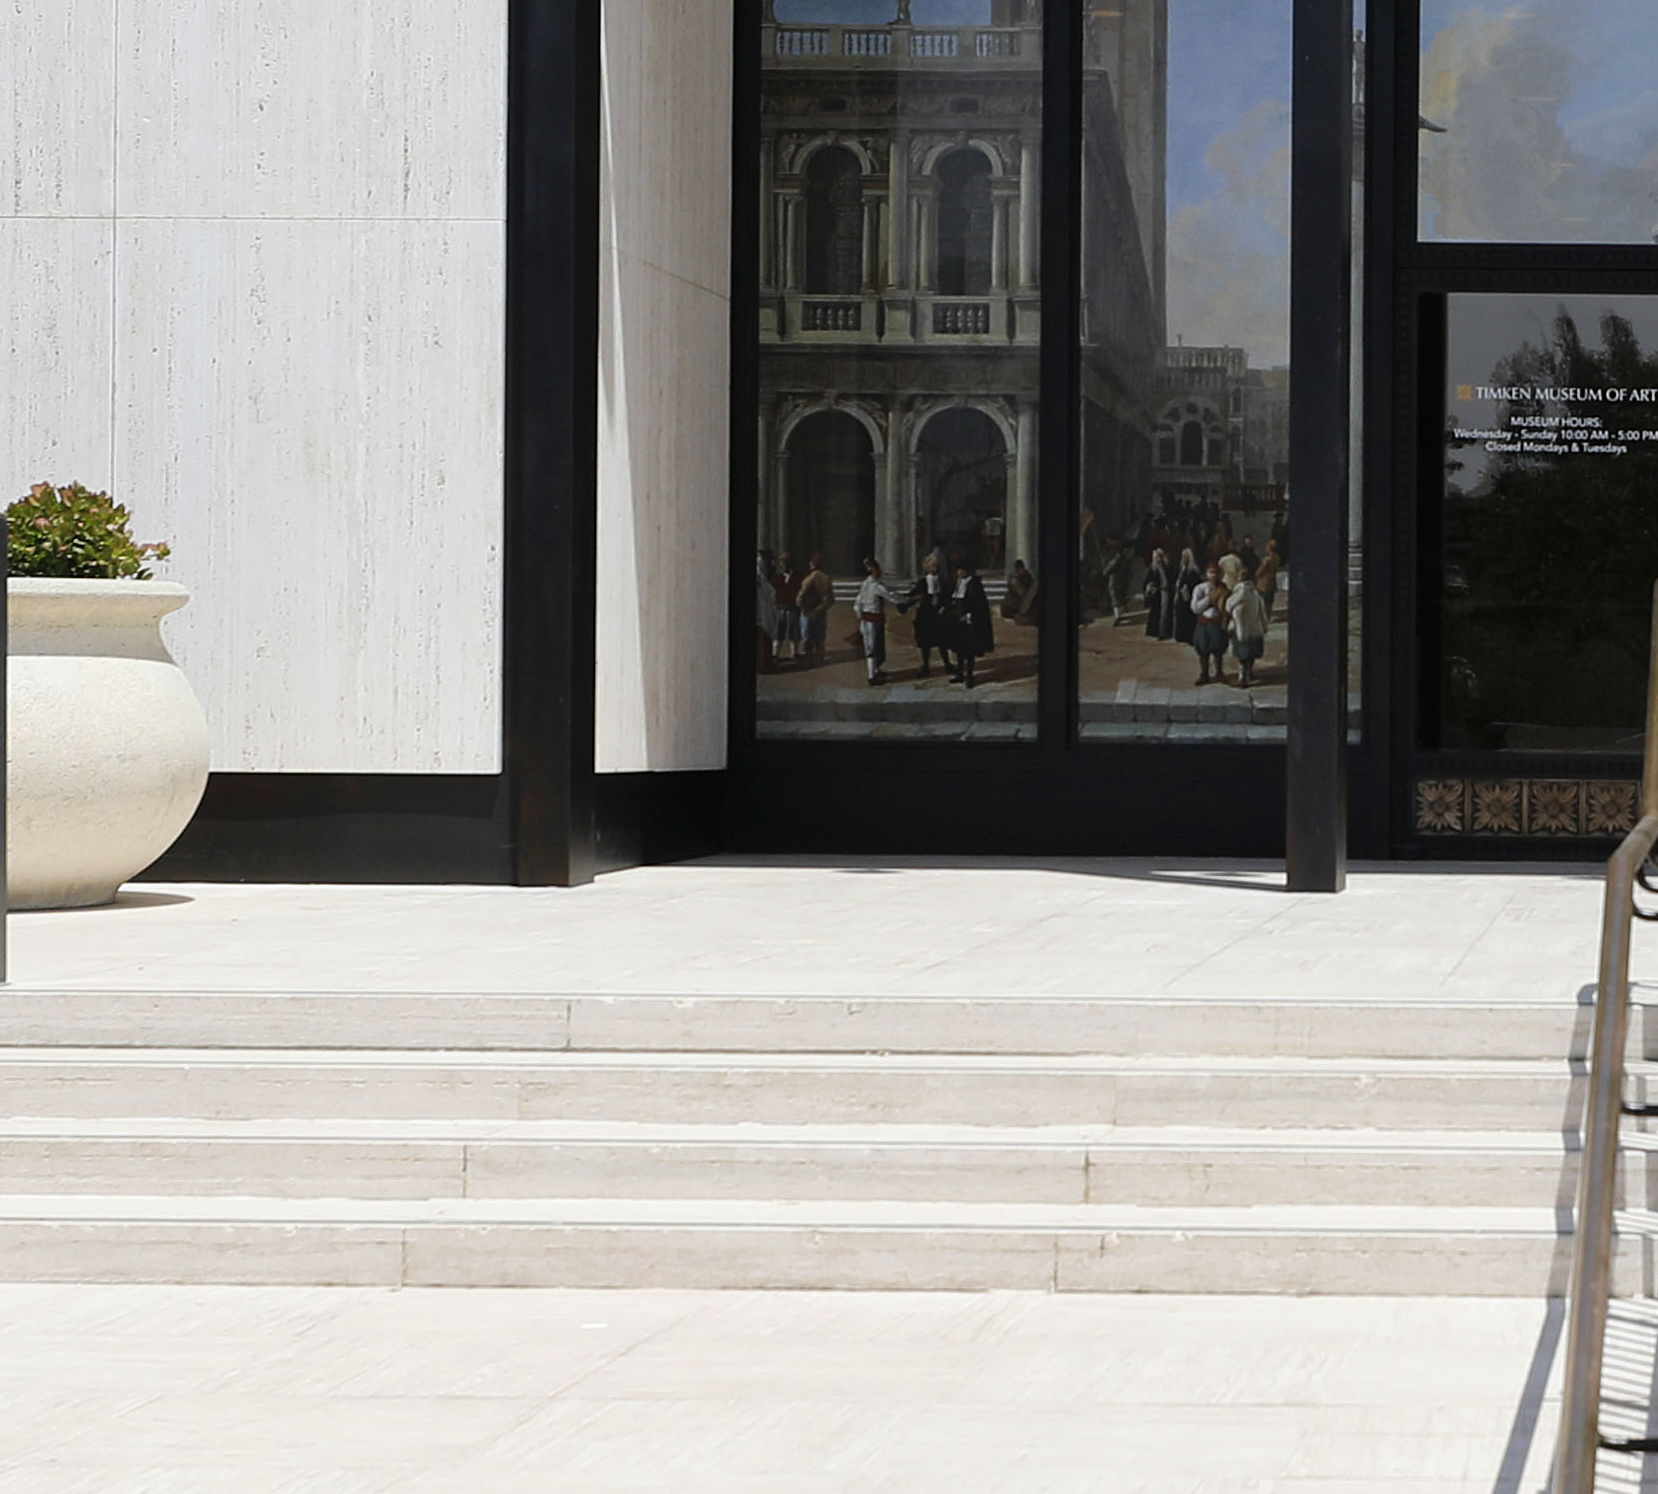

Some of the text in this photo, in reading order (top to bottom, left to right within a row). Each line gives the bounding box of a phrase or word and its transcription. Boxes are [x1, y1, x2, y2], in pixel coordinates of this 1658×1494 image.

[1477, 387, 1658, 402] TIMKEN MUSEUM OF ART
[1511, 417, 1602, 427] MUSEUM HOURS:
[1454, 429, 1512, 440] Wednesday
[1521, 429, 1557, 441] Sunday
[1561, 431, 1588, 440] 10:00
[1590, 431, 1608, 440] AM
[1618, 431, 1639, 440] 5:00
[1642, 432, 1658, 440] PM
[1486, 442, 1520, 451] Closed
[1524, 442, 1569, 454] Mondays
[1583, 443, 1627, 456] Tuesdays
